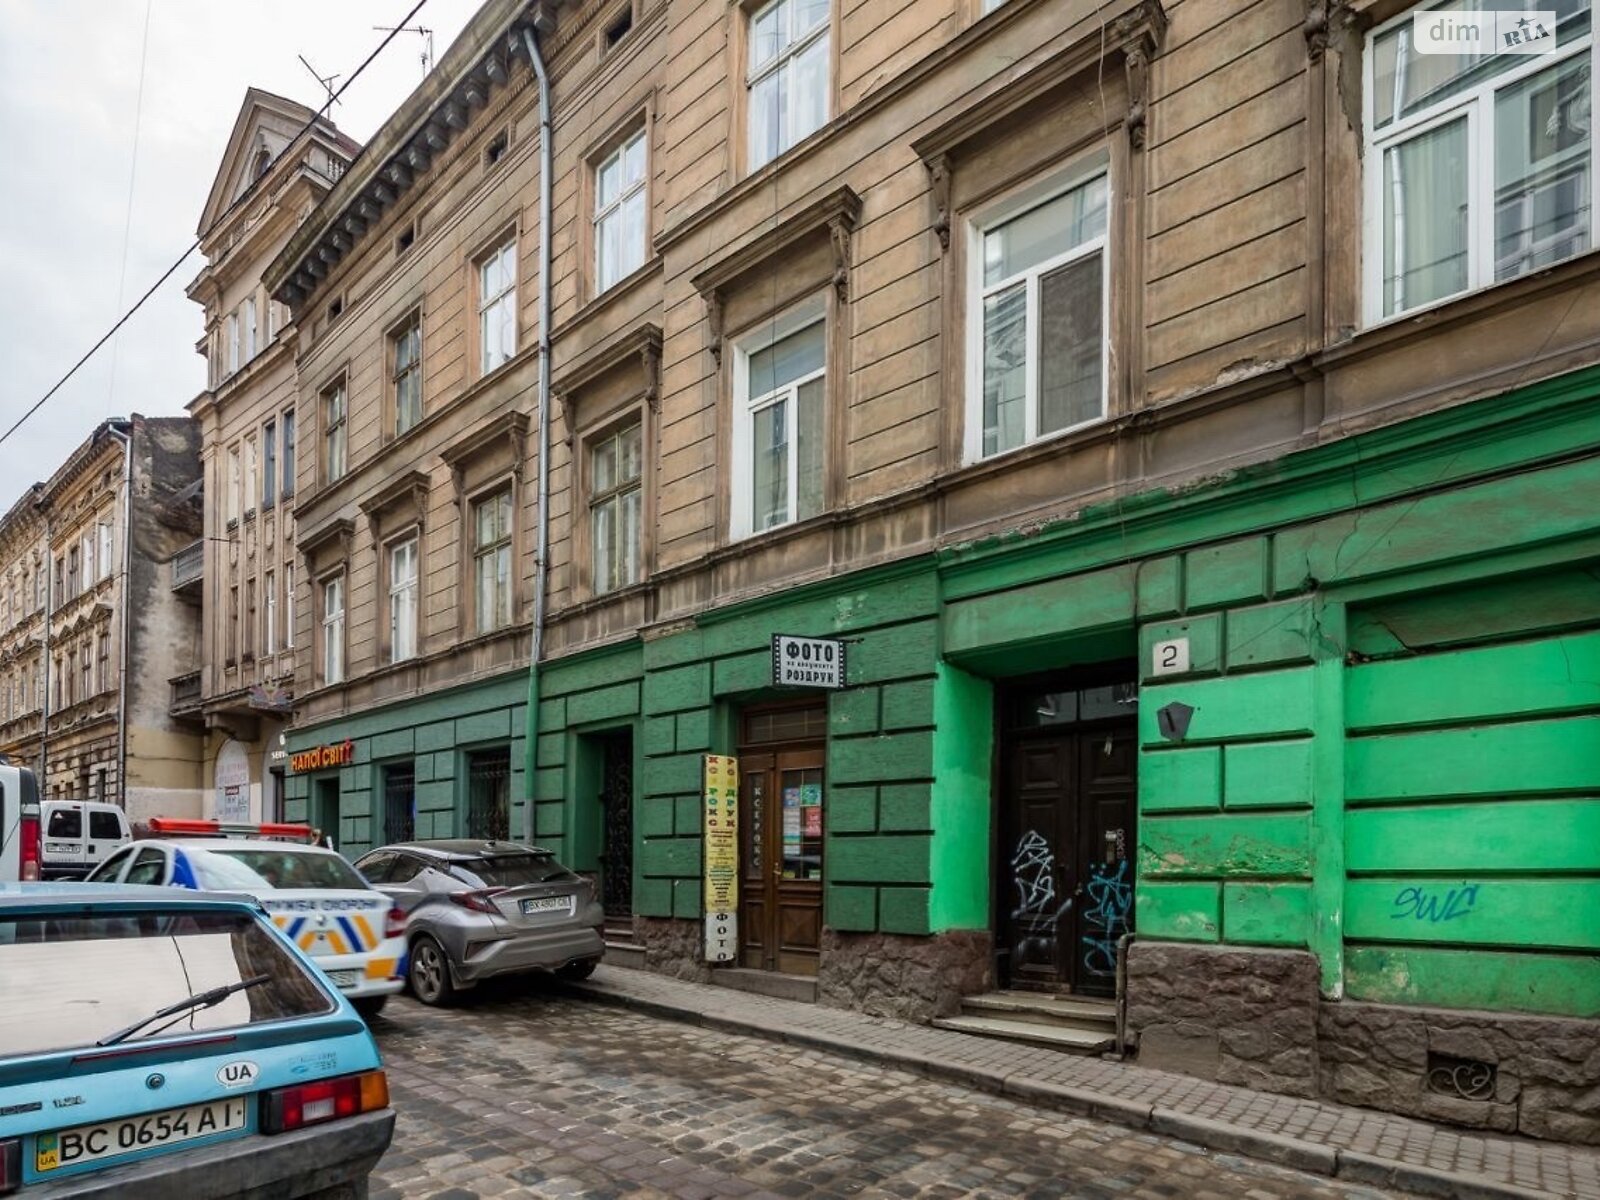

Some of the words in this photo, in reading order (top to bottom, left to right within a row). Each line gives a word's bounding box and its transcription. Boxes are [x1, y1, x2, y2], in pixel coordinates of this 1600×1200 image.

[786, 641, 833, 662] ФОТО
[1163, 645, 1177, 667] 2
[786, 669, 834, 683] РОЗДРУК
[716, 913, 728, 960] ФОТО
[225, 1064, 252, 1081] UA
[60, 1128, 108, 1162] BC
[118, 1112, 189, 1149] 0654
